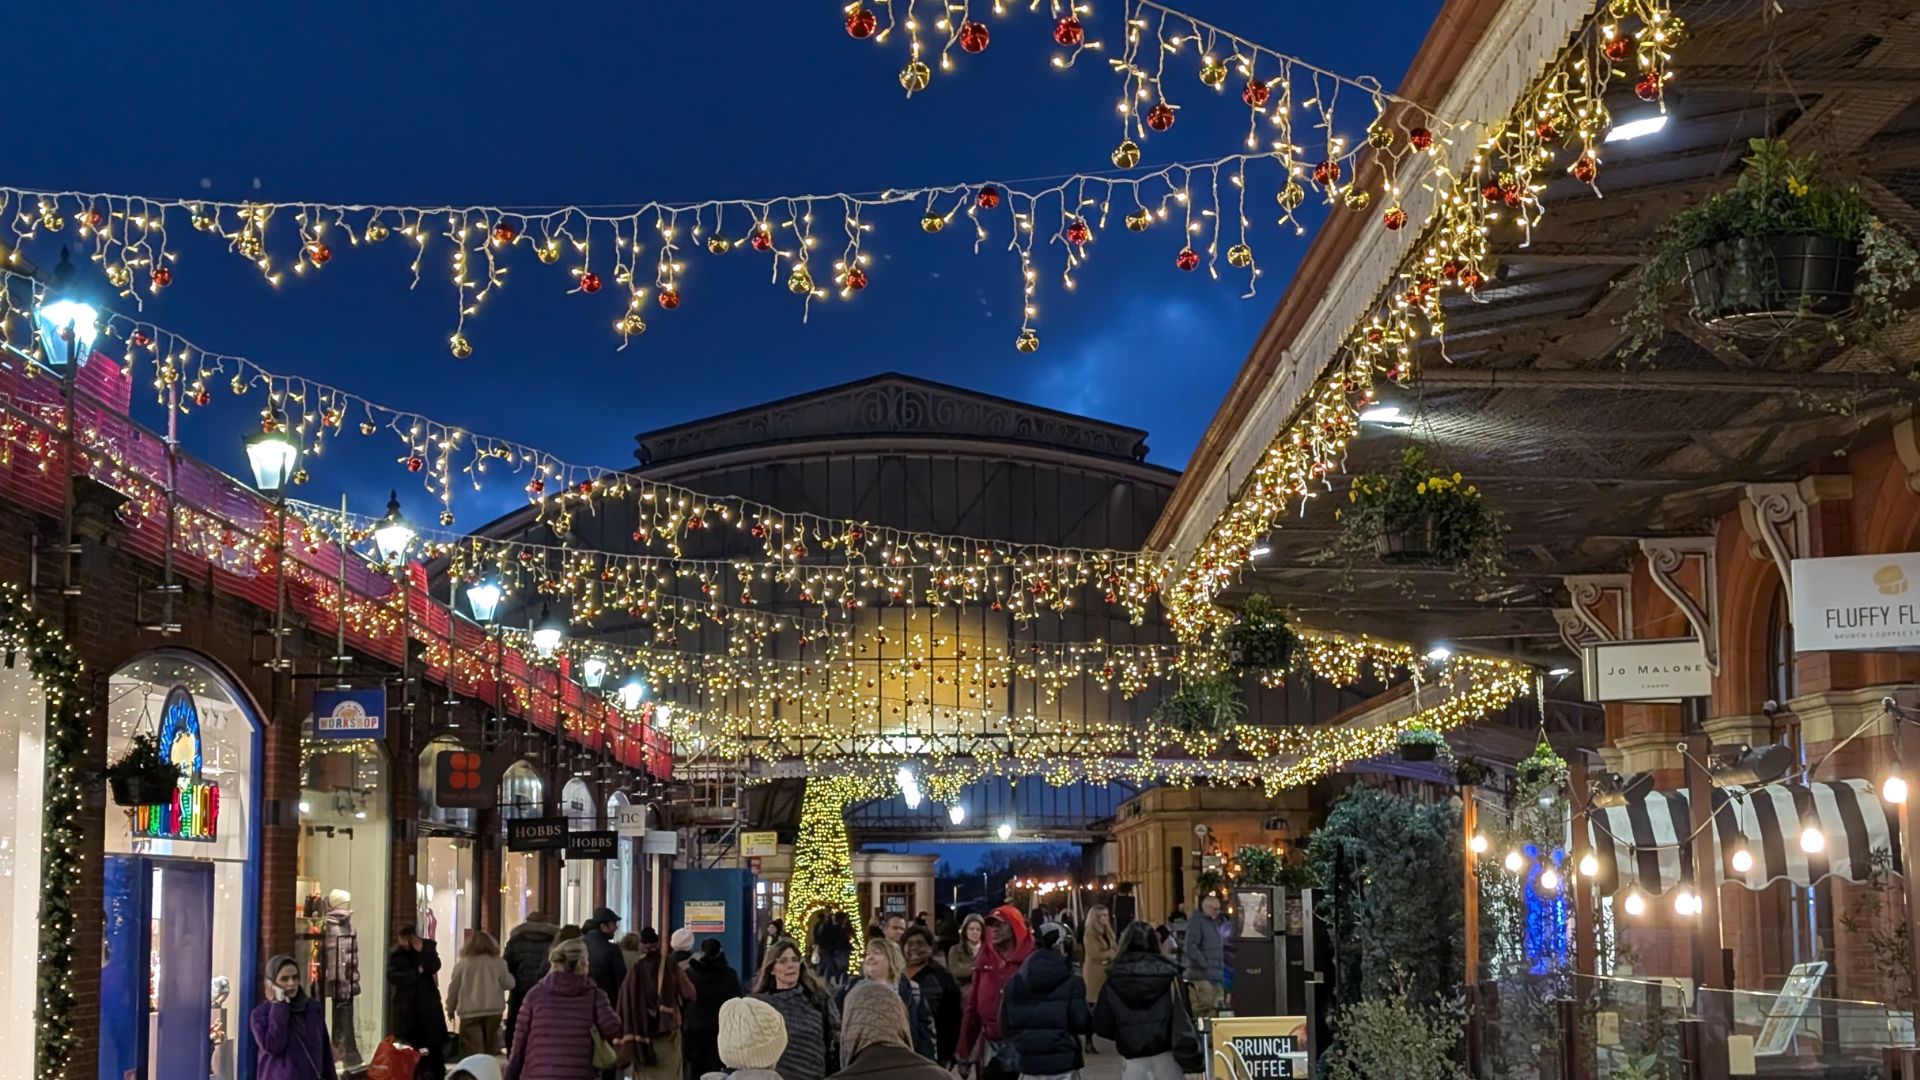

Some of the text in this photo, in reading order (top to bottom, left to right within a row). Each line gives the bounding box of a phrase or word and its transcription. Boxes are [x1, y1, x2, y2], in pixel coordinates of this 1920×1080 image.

[1826, 604, 1920, 629] FLUFFY FL
[1638, 664, 1702, 674] MALONE
[620, 812, 640, 824] nc
[515, 824, 562, 838] HOBBS
[571, 837, 613, 848] HOBBS
[1235, 1038, 1291, 1056] BRUNCH
[1237, 1060, 1291, 1078] OFFEE.
